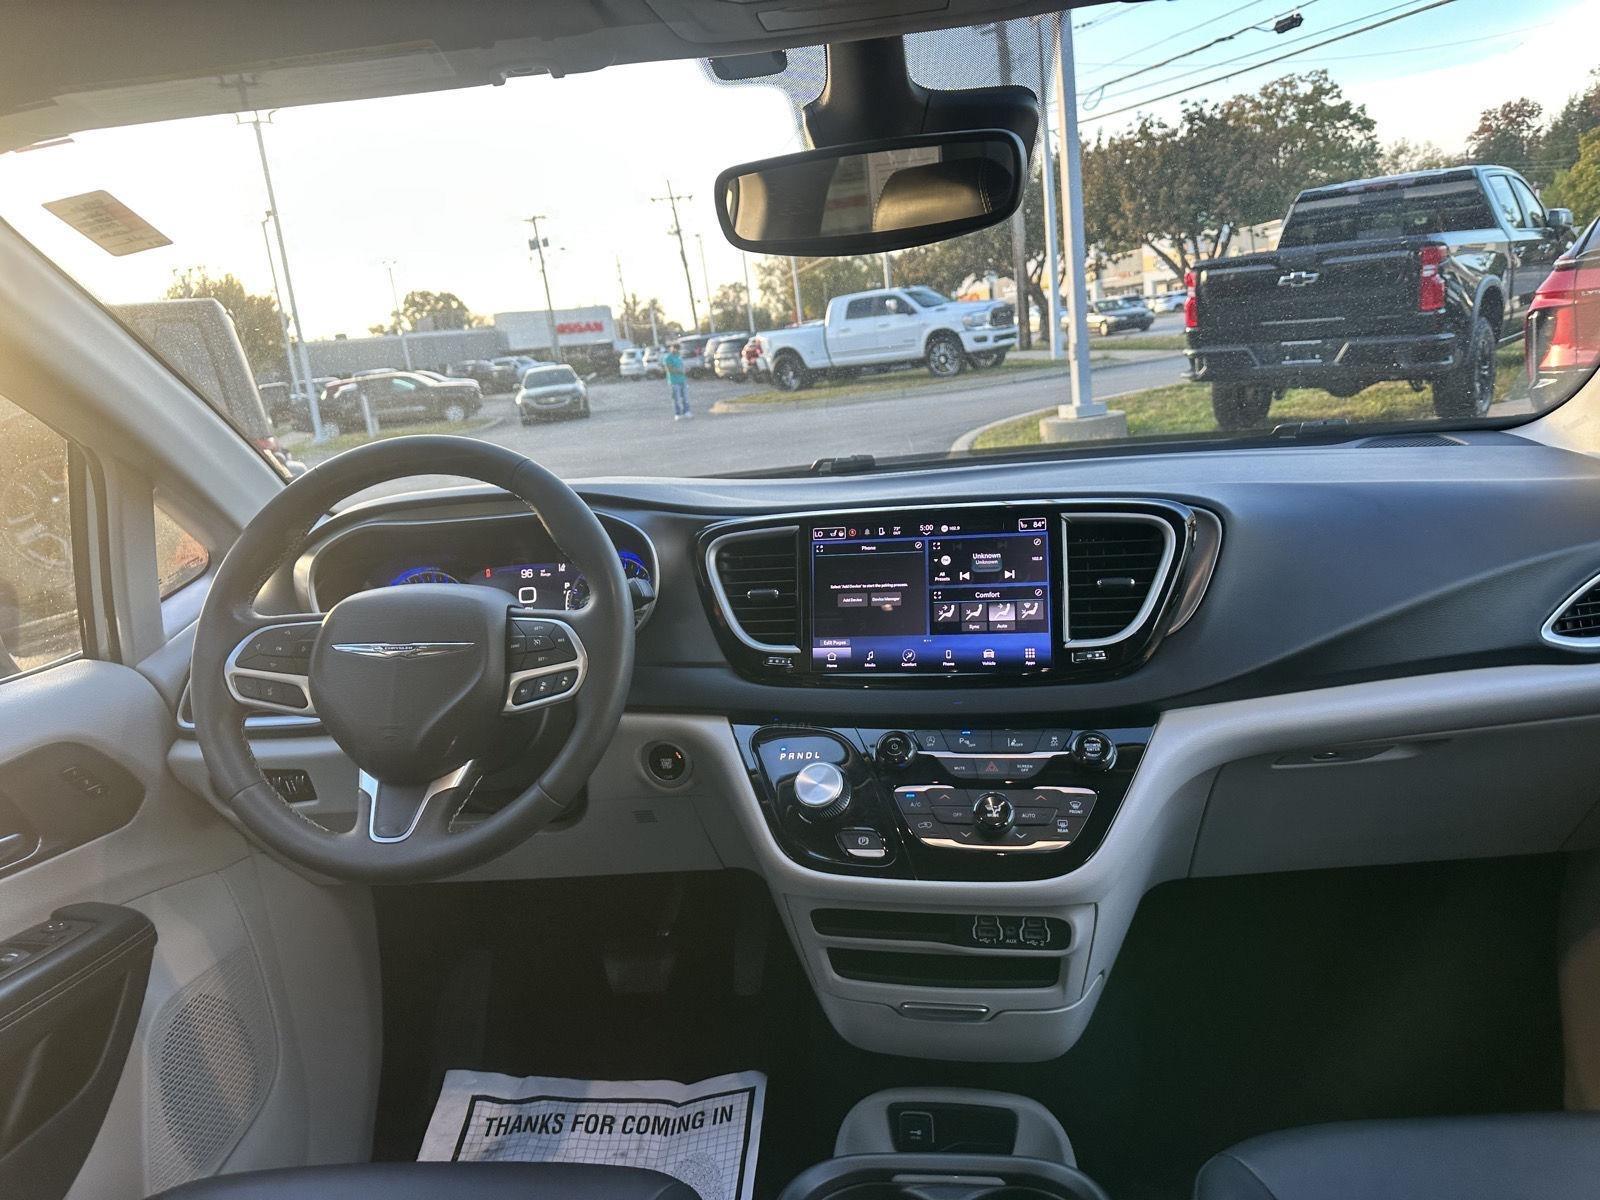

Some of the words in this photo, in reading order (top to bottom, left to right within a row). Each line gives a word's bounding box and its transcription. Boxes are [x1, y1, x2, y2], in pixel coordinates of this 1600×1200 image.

[521, 568, 533, 579] 96
[484, 1112, 566, 1136] THANKS
[570, 1112, 616, 1134] FOR
[621, 1110, 705, 1137] COMING
[712, 1104, 734, 1126] IN
